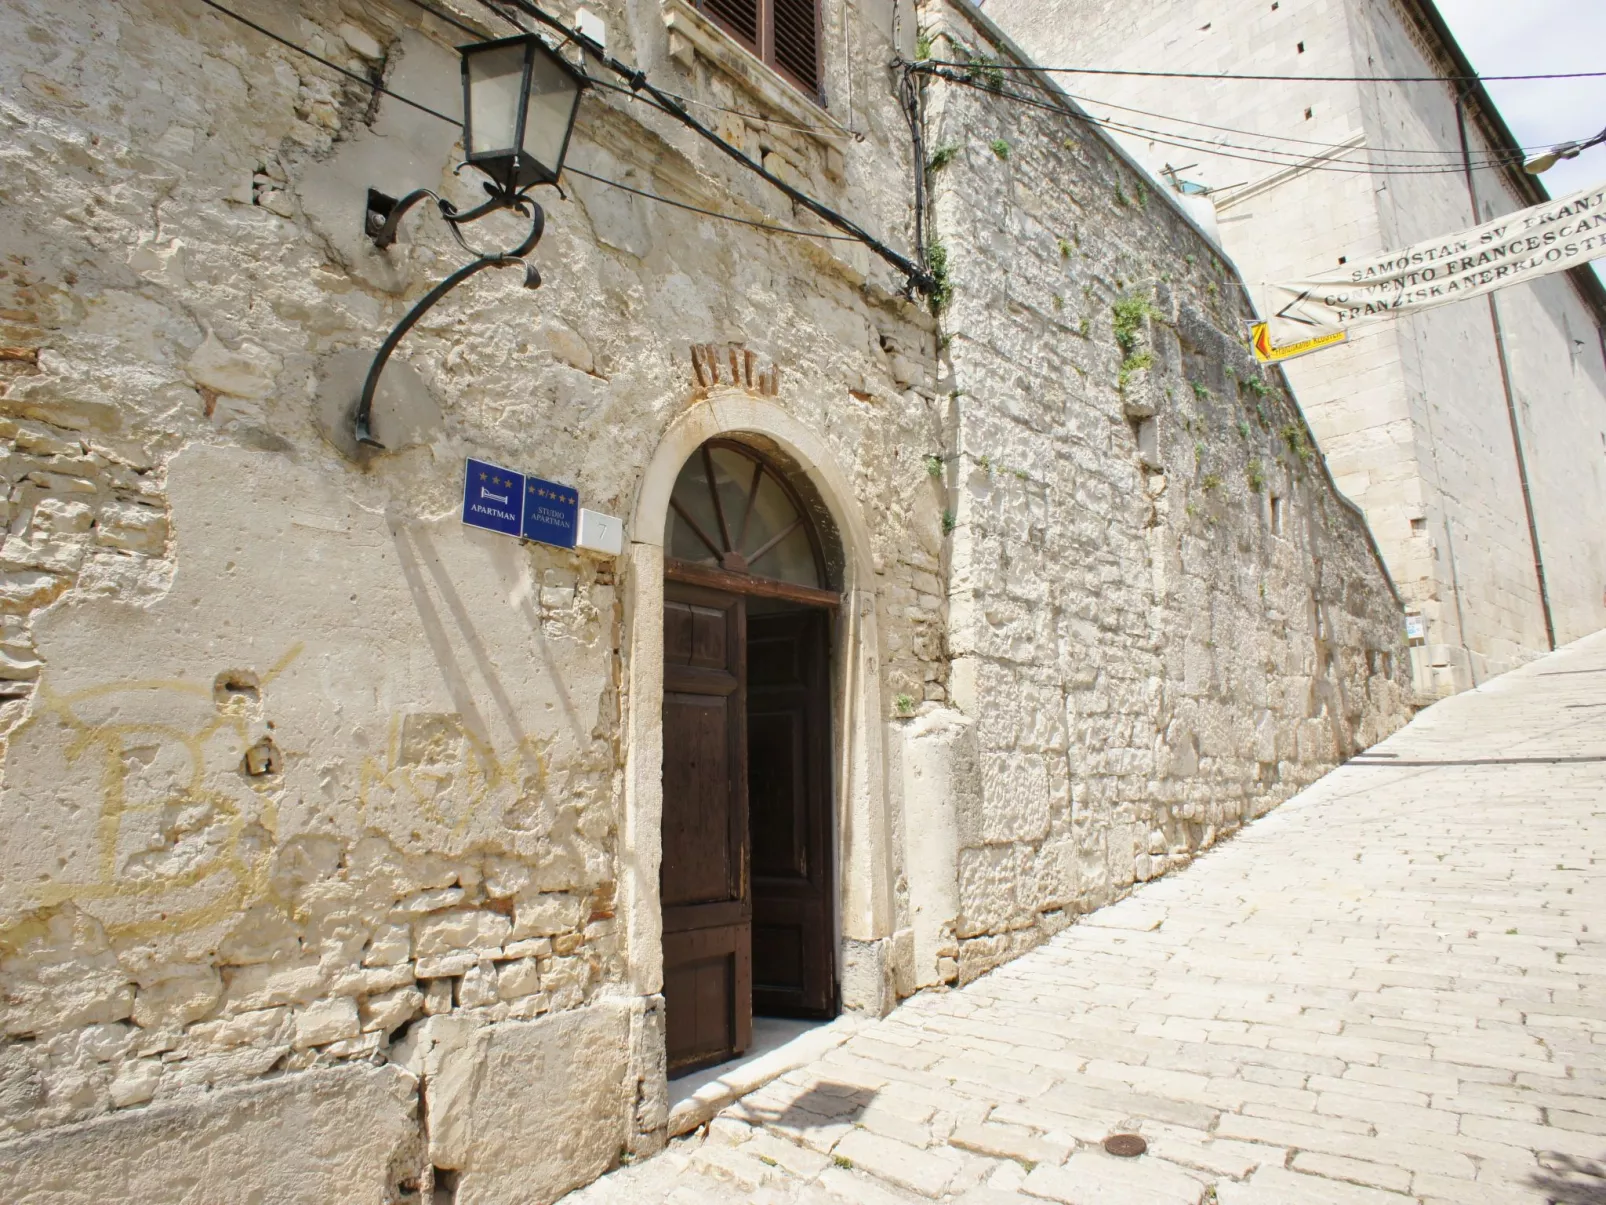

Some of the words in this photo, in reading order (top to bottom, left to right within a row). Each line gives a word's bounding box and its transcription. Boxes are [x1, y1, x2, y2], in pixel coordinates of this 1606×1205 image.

[1352, 240, 1467, 282] SAMOSTAN
[1480, 226, 1507, 245] SV
[1523, 192, 1605, 229] FRANJ
[1324, 268, 1436, 306] CONVENTO
[470, 503, 516, 521] APARTMAN
[531, 513, 570, 529] APARTMAN
[538, 506, 565, 520] STUDIO
[598, 523, 607, 541] 7
